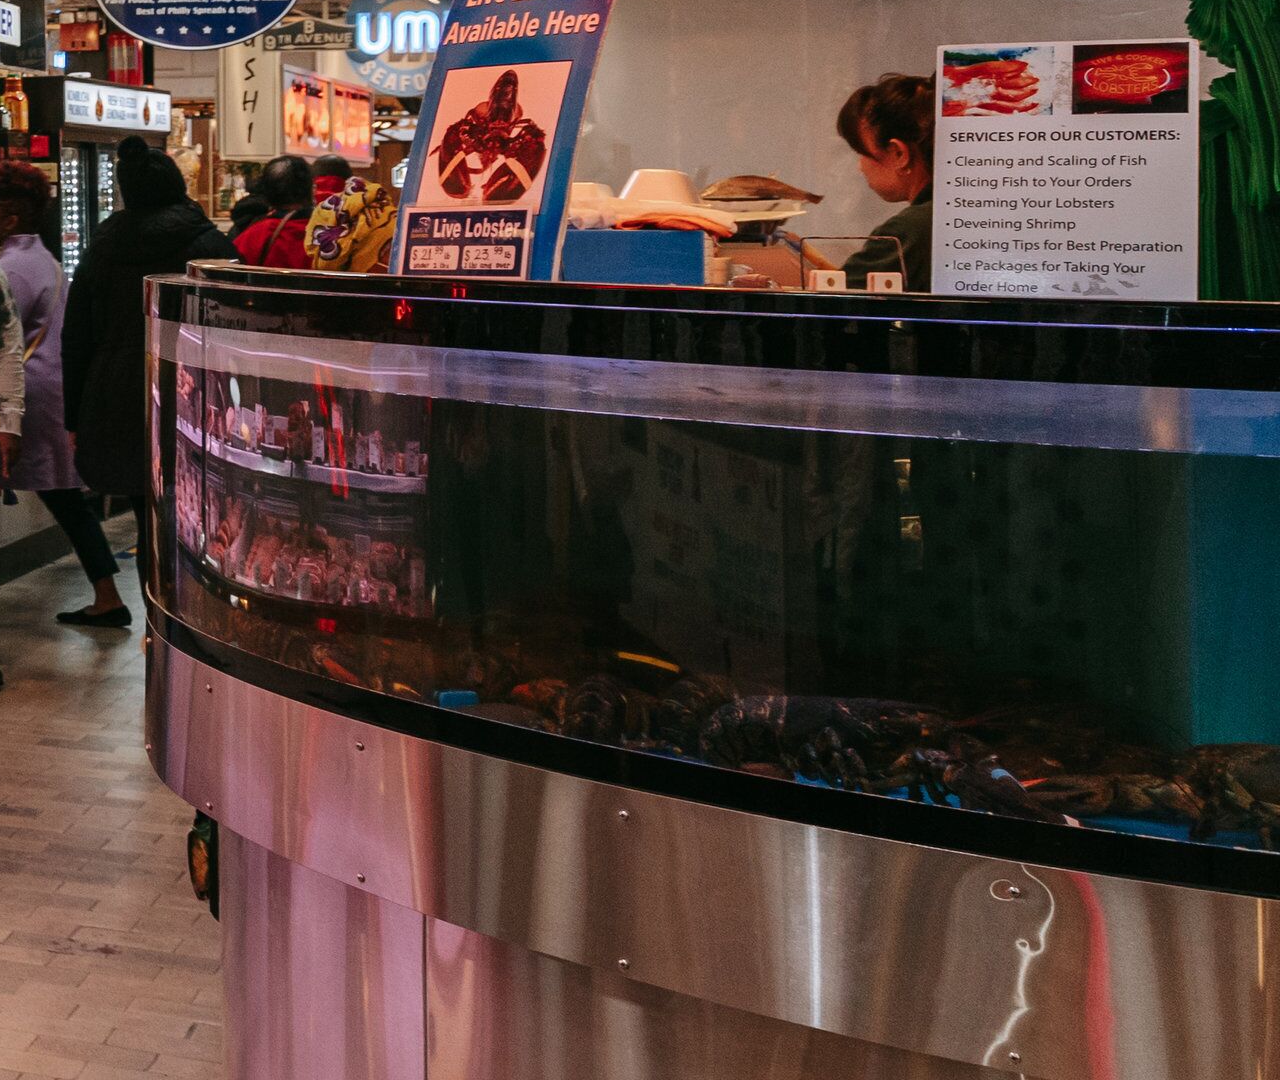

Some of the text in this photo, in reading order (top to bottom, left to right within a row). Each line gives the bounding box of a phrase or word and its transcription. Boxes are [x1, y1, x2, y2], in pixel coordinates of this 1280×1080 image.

[136, 7, 155, 16] Best
[156, 7, 166, 16] of
[167, 6, 191, 16] Philly
[192, 6, 226, 16] Spreads
[303, 20, 315, 33] B
[443, 9, 600, 46] Available Here
[295, 31, 354, 44] AVENUE
[358, 59, 431, 92] SEAFO
[1093, 79, 1159, 95] LOBSTERS
[949, 128, 1181, 143] SERVICES FOR OUR CUSTOMERS:
[954, 154, 1147, 169] Cleaning and Scaling of Fish
[953, 175, 1133, 189] Slicing Fish to Your Orders
[953, 196, 1115, 210] Steaming Your Lobsters
[433, 218, 461, 238] Live
[464, 217, 522, 238] Lobster
[953, 217, 1077, 232] Deveining Shrimp
[953, 239, 1183, 255] Cooking Tips for Best Preparation
[953, 259, 1146, 276] Ice Packages for Taking Your
[954, 280, 1039, 293] Order Home
